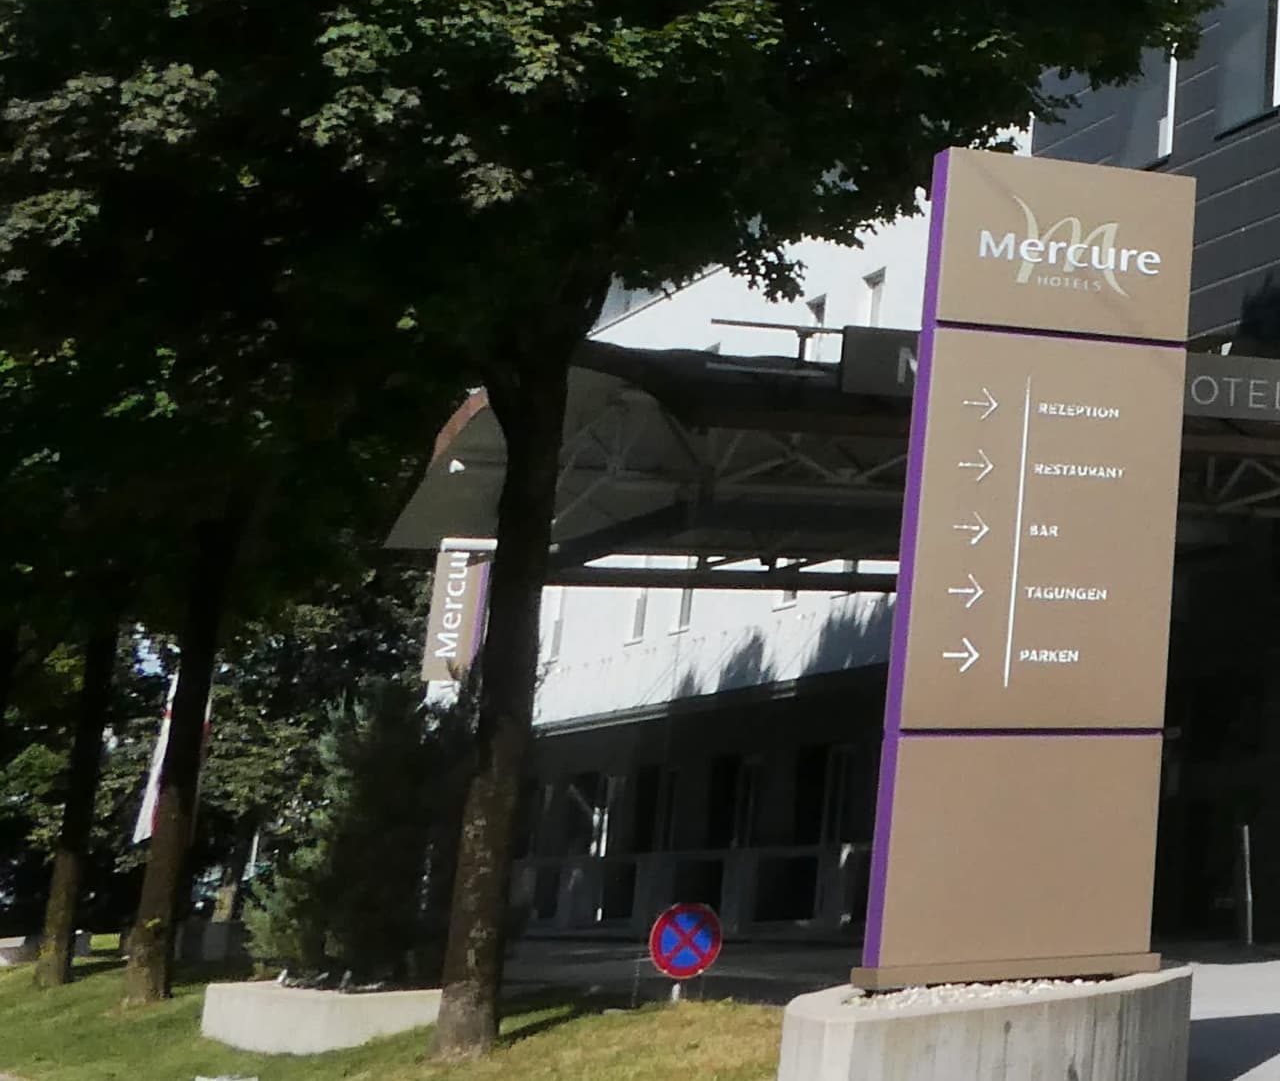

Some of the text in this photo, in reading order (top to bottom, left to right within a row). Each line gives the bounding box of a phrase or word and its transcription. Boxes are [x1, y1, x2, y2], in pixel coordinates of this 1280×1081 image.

[978, 229, 1162, 276] Mercure
[1037, 275, 1102, 292] HOTELS
[1038, 402, 1120, 419] REZEPTION
[1033, 463, 1125, 479] RESTAURANT
[1029, 524, 1059, 537] BAR
[1025, 586, 1108, 600] TAGUNGEN
[1019, 649, 1080, 663] PARKEN
